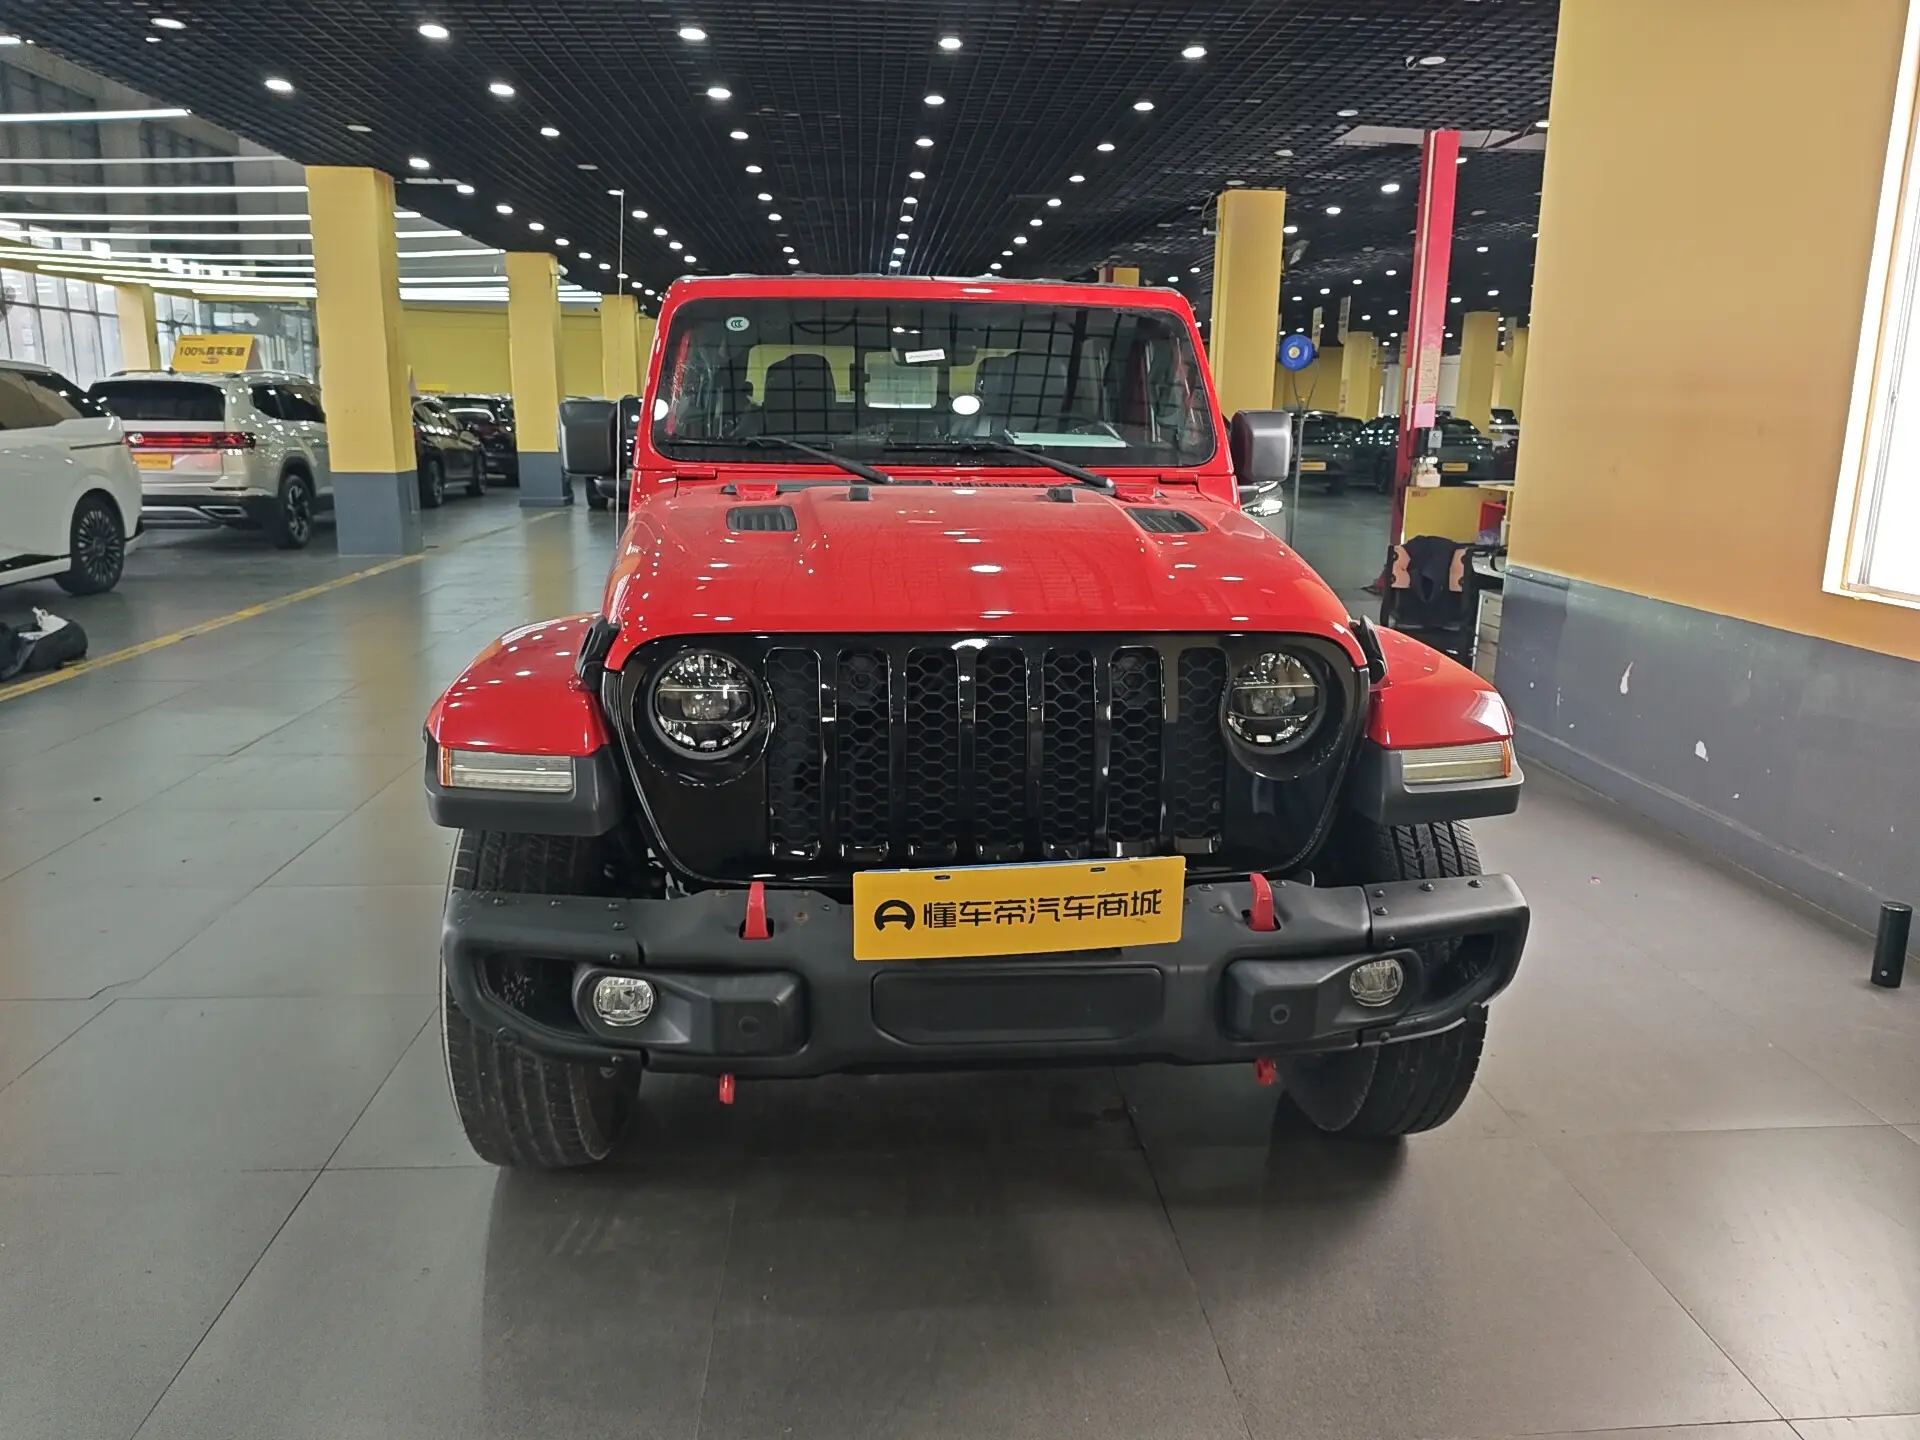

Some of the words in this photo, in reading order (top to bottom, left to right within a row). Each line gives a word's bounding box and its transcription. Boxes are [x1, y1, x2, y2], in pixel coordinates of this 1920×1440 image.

[923, 888, 1162, 929] 懂车帝汽车商城
